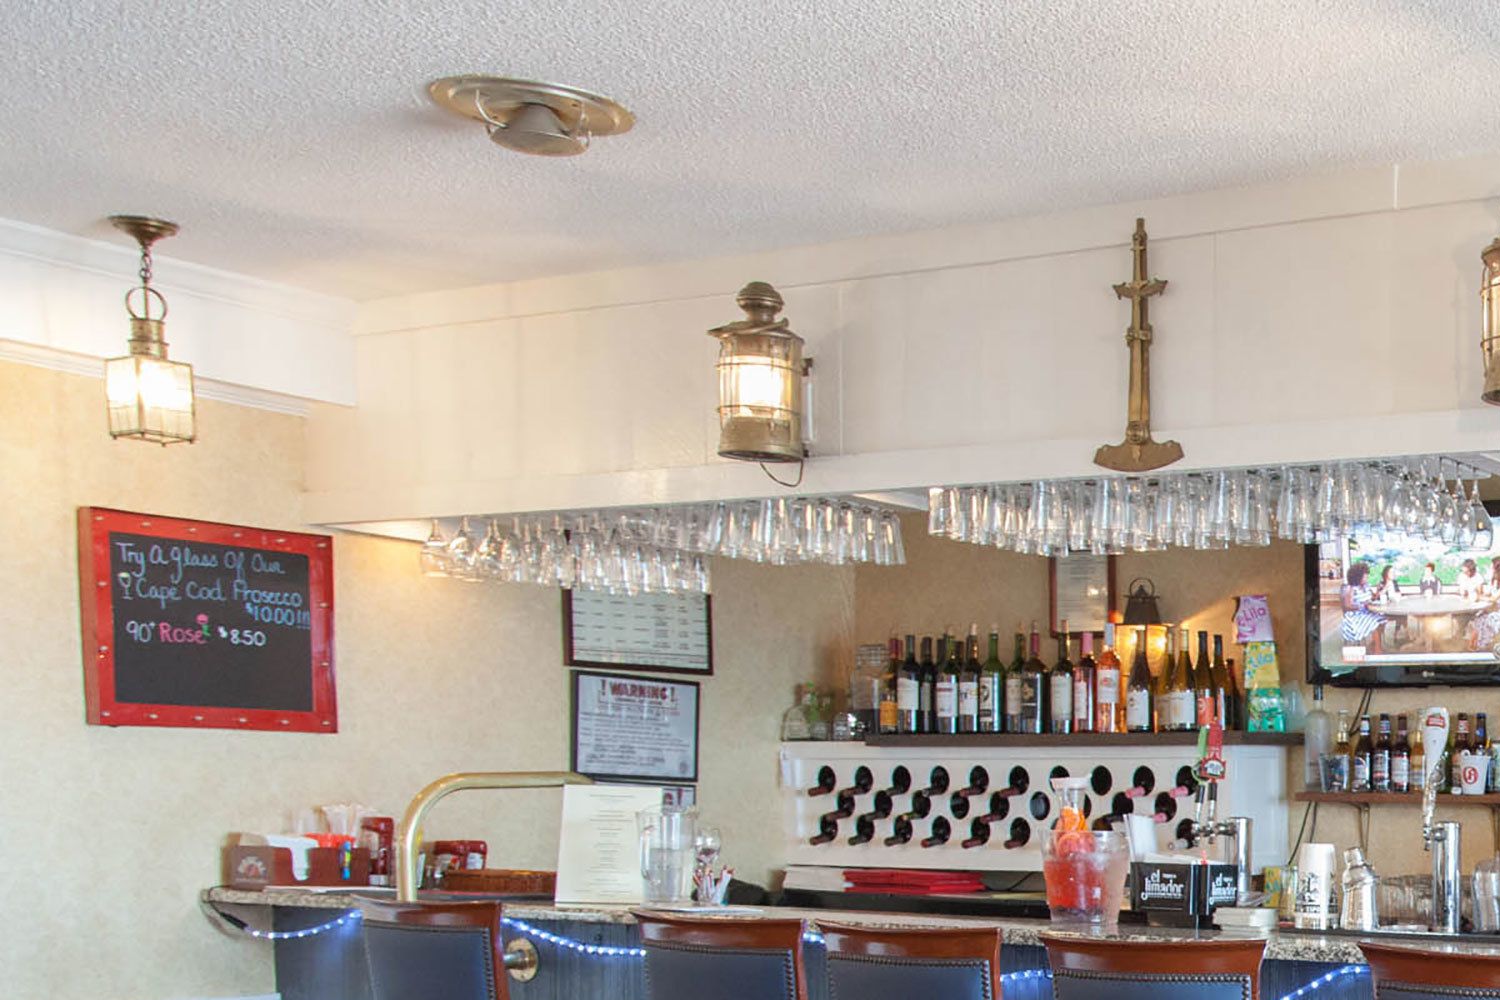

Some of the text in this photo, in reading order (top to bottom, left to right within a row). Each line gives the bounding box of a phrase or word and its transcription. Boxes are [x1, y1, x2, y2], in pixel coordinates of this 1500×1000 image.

[115, 541, 146, 578] Try
[135, 577, 303, 610] Cape Cod Prosecco
[611, 682, 667, 701] WARNING
